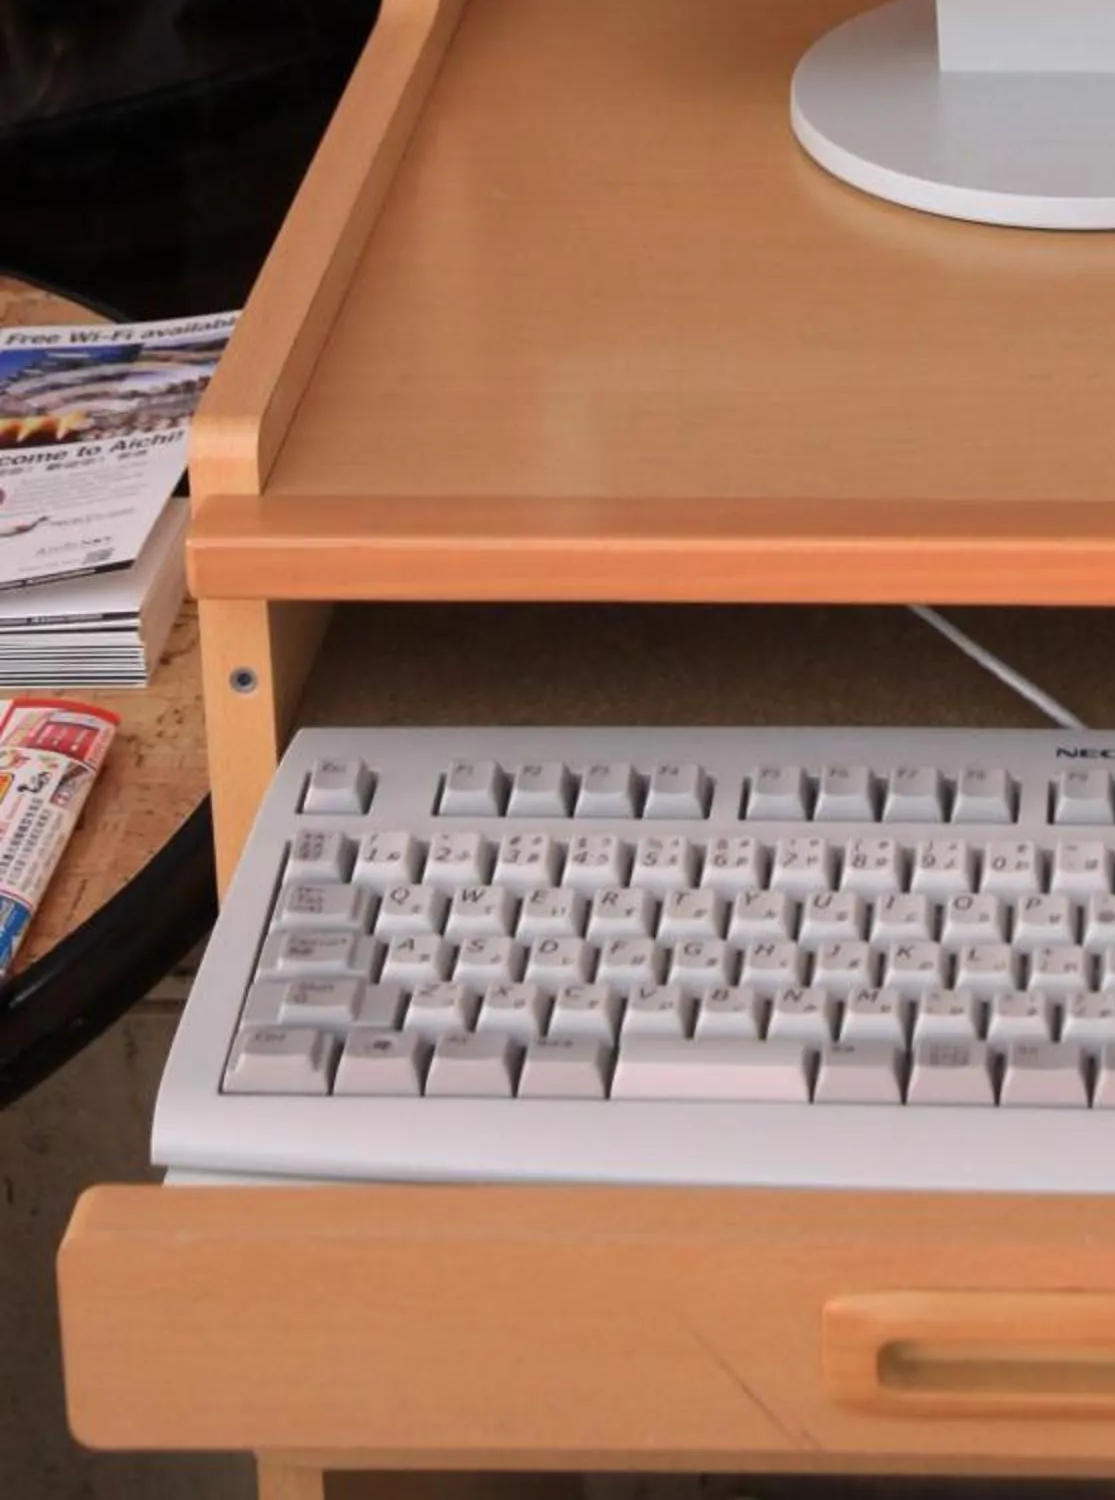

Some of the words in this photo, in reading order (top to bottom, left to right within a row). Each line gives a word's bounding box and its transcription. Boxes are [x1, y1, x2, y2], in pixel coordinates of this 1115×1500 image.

[5, 331, 62, 346] Free
[69, 328, 135, 344] Wi-Fi
[141, 315, 238, 340] availabl
[77, 445, 102, 458] to
[389, 886, 410, 905] Q
[461, 888, 486, 903] W
[530, 890, 548, 904] E
[601, 890, 619, 905] R
[675, 891, 690, 906] T
[744, 891, 760, 907] Y
[811, 894, 833, 910] U
[953, 896, 974, 911] O
[1024, 896, 1043, 912] P
[397, 937, 416, 951] A
[466, 939, 485, 953] S
[538, 940, 559, 954] D
[683, 942, 703, 956] G
[754, 943, 775, 956] H
[896, 945, 915, 960] K
[967, 947, 982, 962] L
